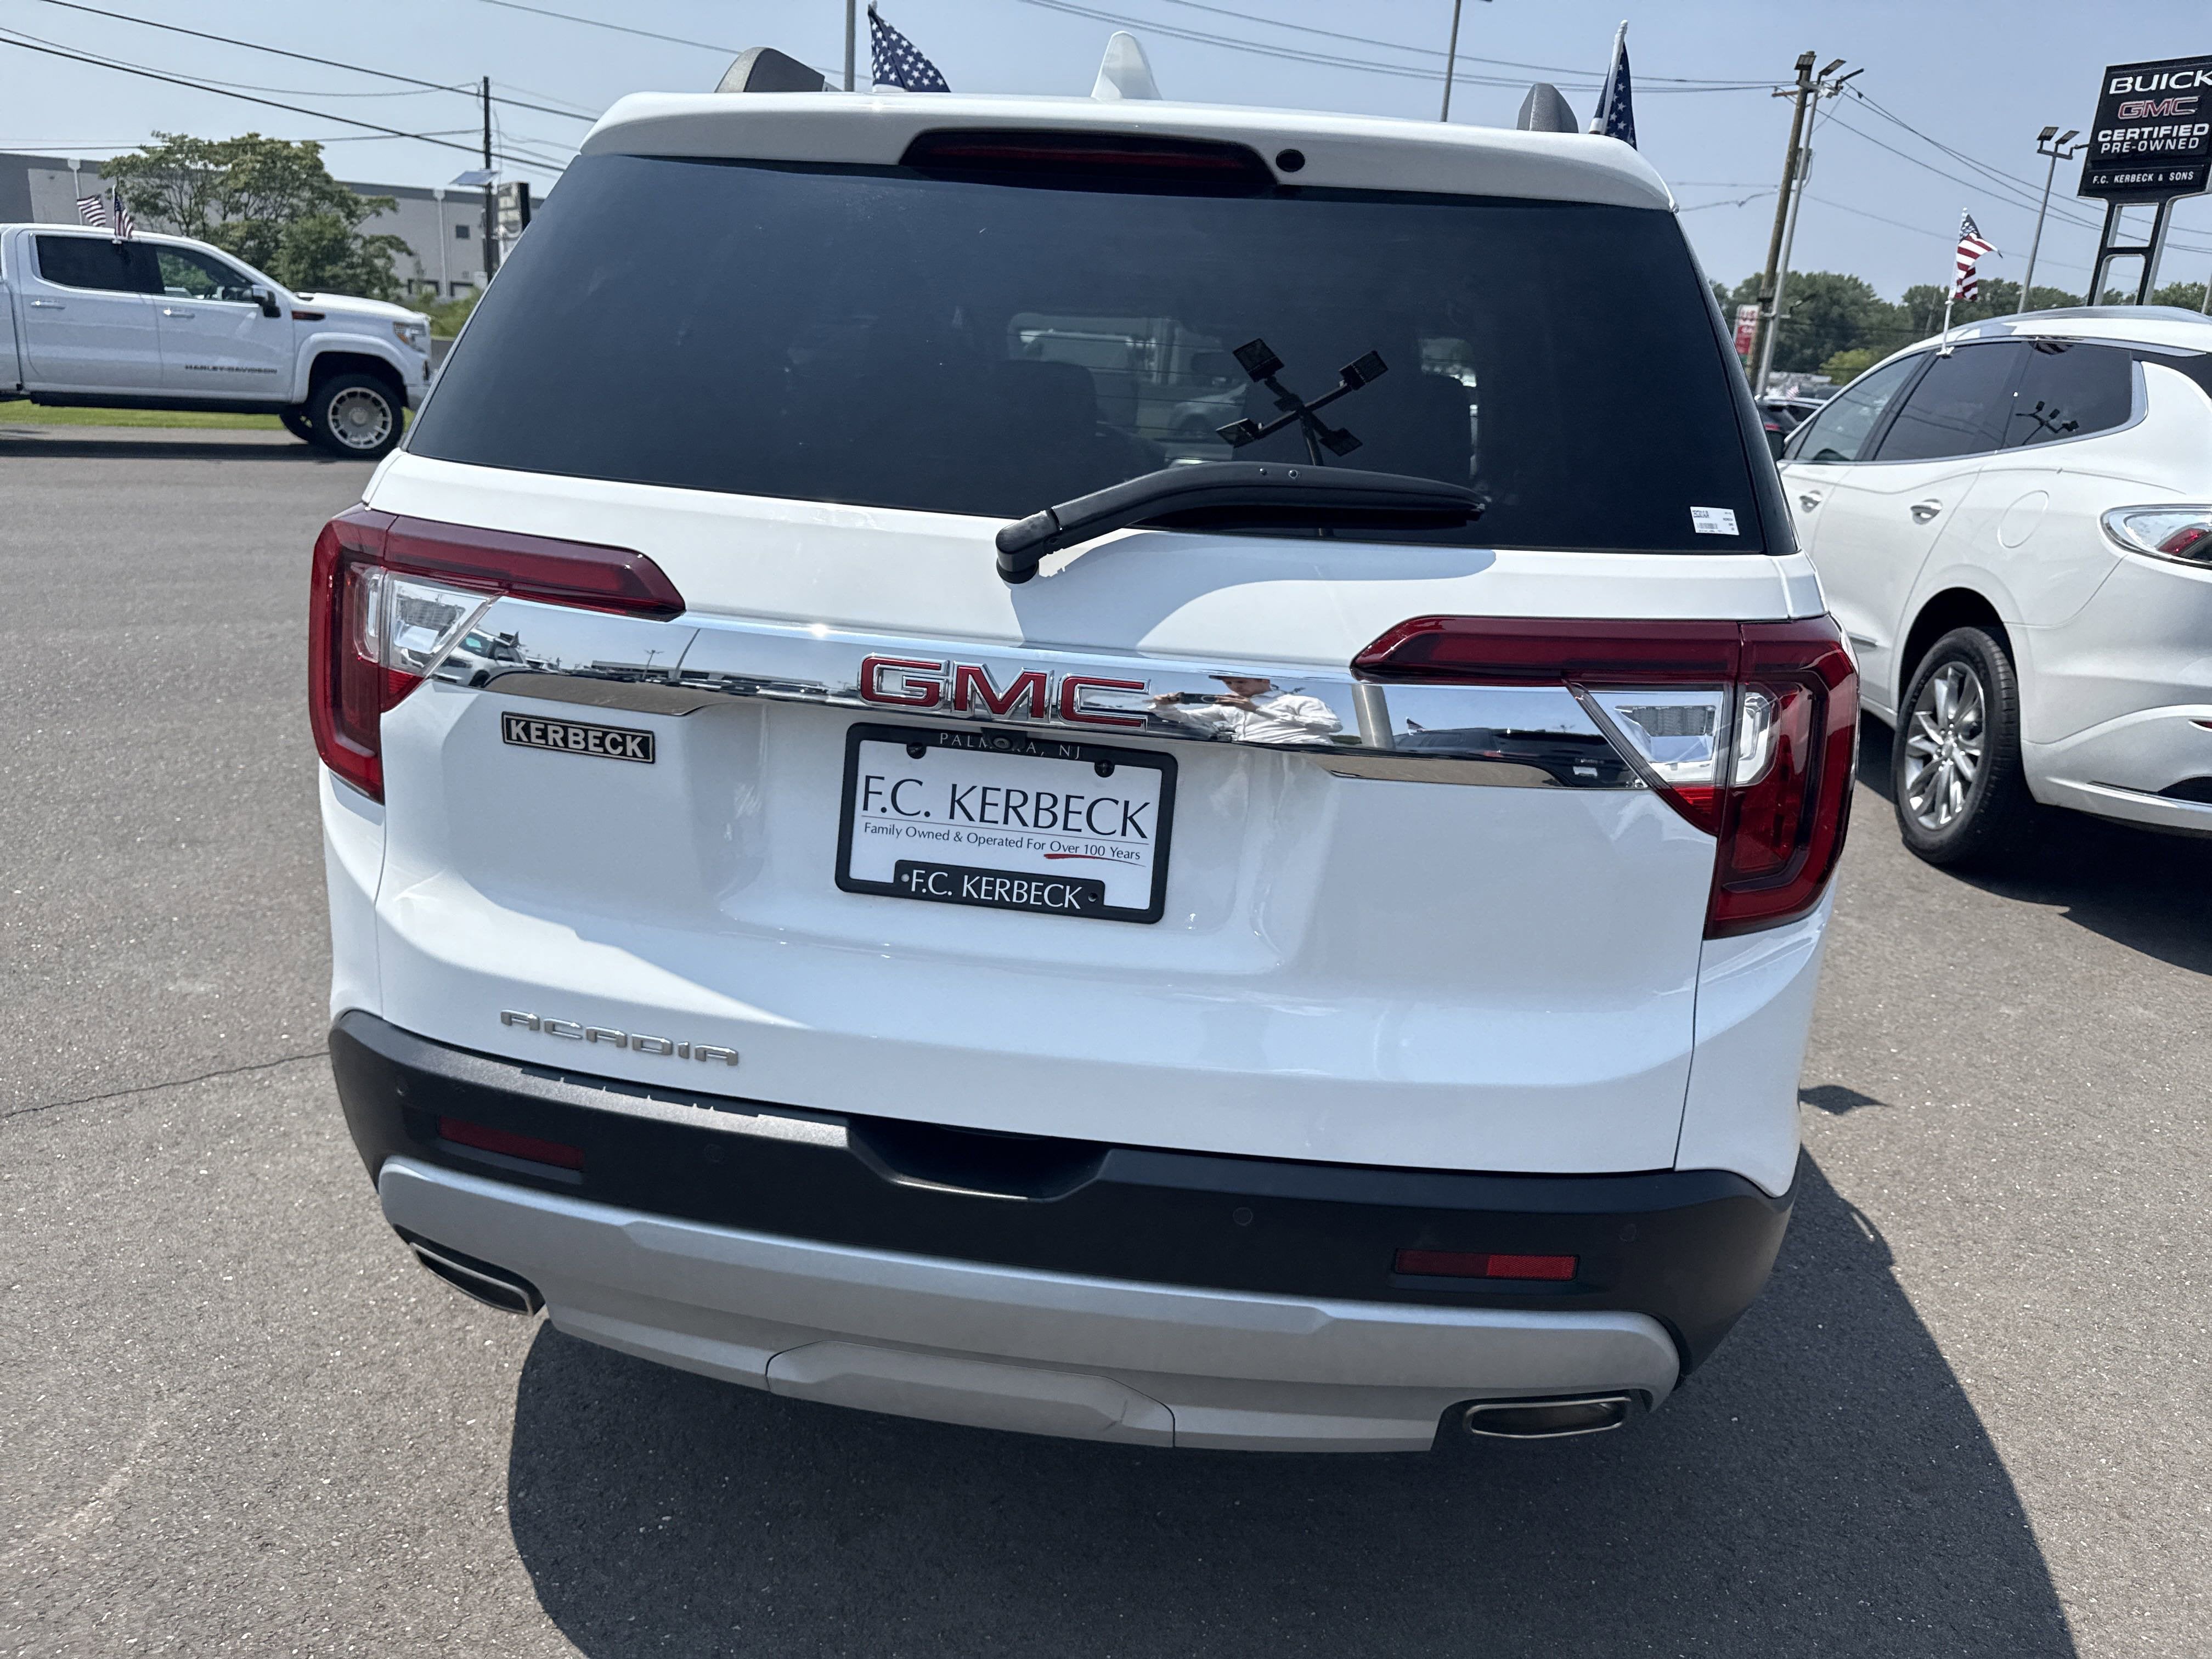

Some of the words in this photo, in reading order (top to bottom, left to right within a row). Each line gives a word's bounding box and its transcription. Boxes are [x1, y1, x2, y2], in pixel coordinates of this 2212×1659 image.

[2109, 70, 2212, 94] BUICK
[2118, 96, 2199, 120] GMC
[2097, 123, 2209, 142] CERTIFIED
[2101, 138, 2199, 154] PRE-OWNED
[2114, 173, 2154, 183] KERBECK
[2169, 171, 2194, 180] SONS
[858, 652, 1151, 732] GMC
[511, 720, 645, 758] KERBECK
[1059, 744, 1080, 760] NJ
[862, 775, 930, 817] F.C.
[949, 784, 1150, 839] KERBECK
[865, 823, 902, 839] Family
[905, 827, 950, 842] Owned
[953, 832, 963, 842] &
[967, 833, 1023, 850] Operated
[1027, 839, 1045, 850] For
[1050, 841, 1080, 854] Over
[1084, 844, 1105, 856] 100
[1110, 847, 1141, 860] Years
[911, 870, 952, 896] F.C.
[962, 874, 1082, 909] KERBECK
[500, 1009, 738, 1066] ACADIA
